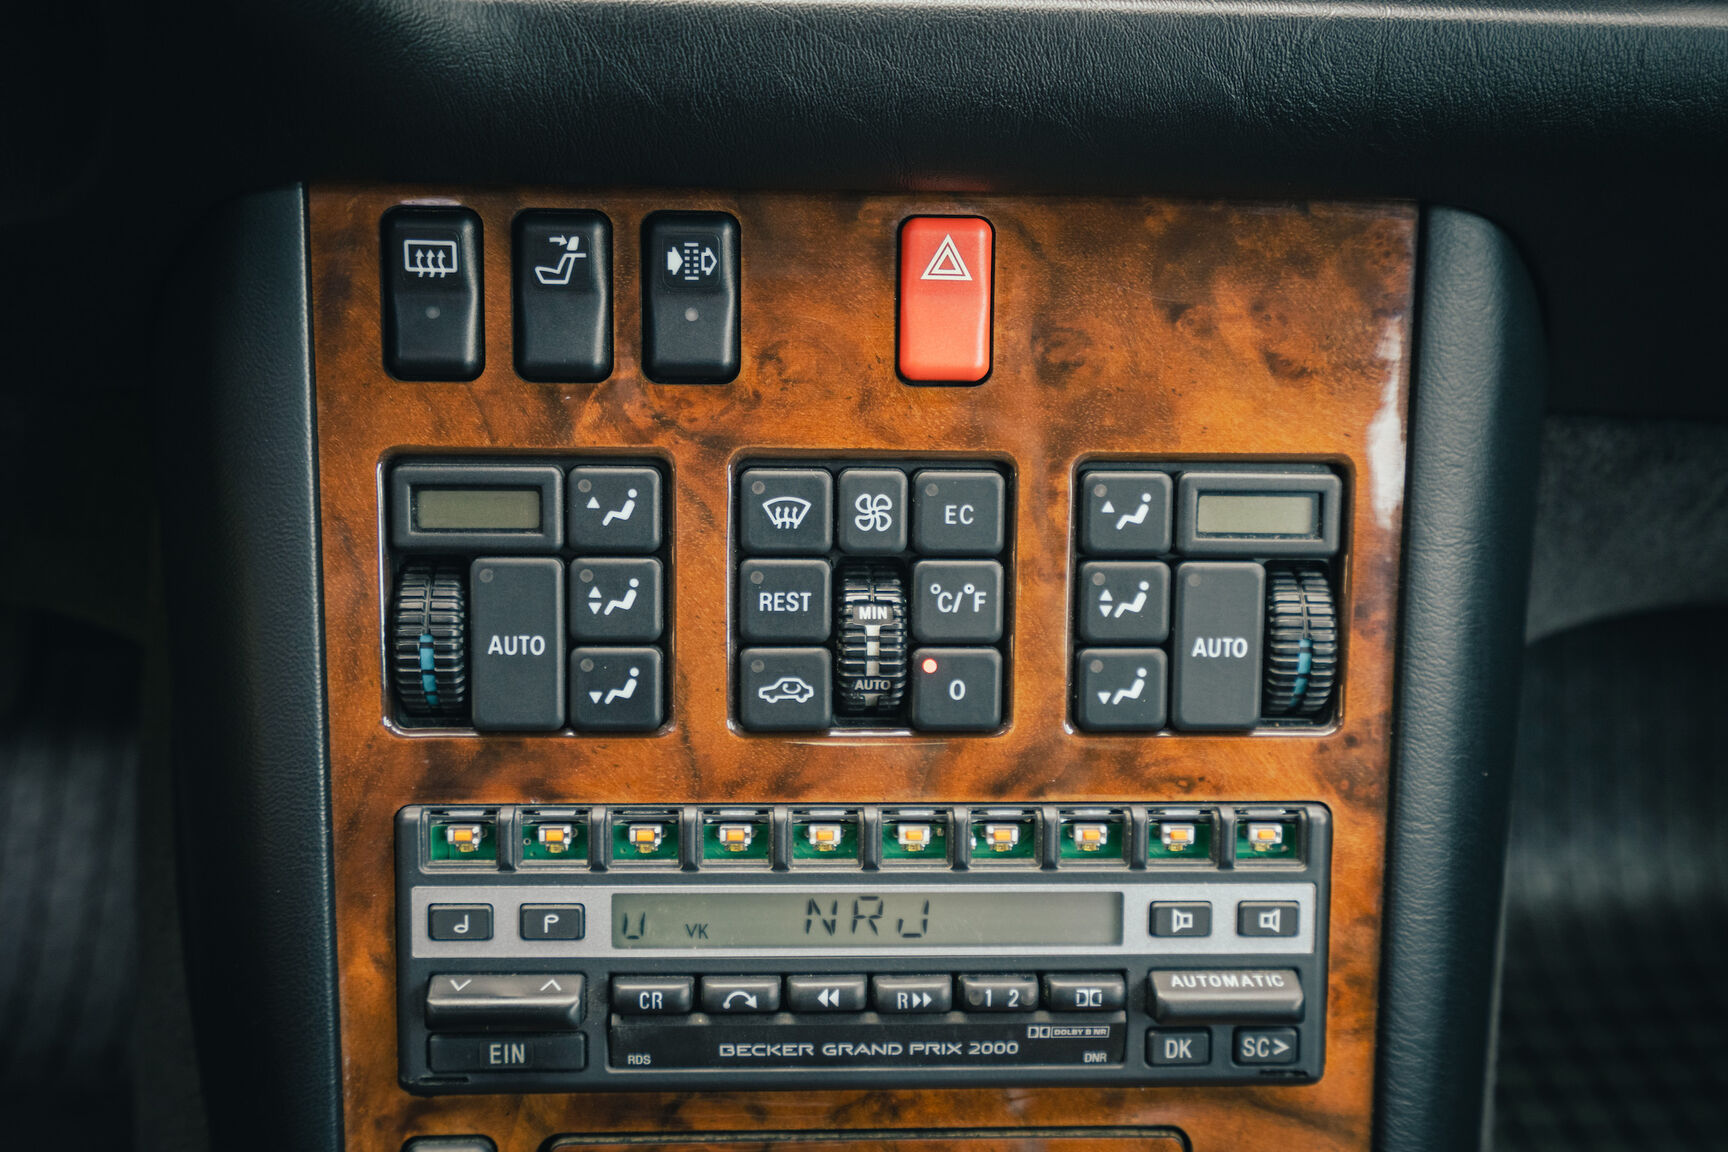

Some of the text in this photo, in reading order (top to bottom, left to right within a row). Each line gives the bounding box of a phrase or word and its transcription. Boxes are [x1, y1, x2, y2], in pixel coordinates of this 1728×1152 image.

[944, 504, 975, 525] EC
[758, 591, 812, 613] REST
[857, 605, 889, 621] MIN
[487, 635, 546, 657] AUTO
[1191, 637, 1249, 659] AUTO
[853, 678, 892, 692] AUTO
[804, 895, 931, 939] NRJ
[684, 922, 710, 940] VK
[1170, 974, 1286, 989] AUTOMATIC
[638, 991, 664, 1010] CR
[985, 988, 1020, 1008] 1 2
[1053, 1028, 1084, 1036] DOLBY
[1093, 1028, 1107, 1036] NR
[488, 1043, 526, 1065] EIN
[719, 1042, 1020, 1057] BECKER GRAND PRIX 2000
[1084, 1052, 1107, 1064] DNR
[1165, 1039, 1192, 1059] DK
[627, 1054, 651, 1065] RDS
